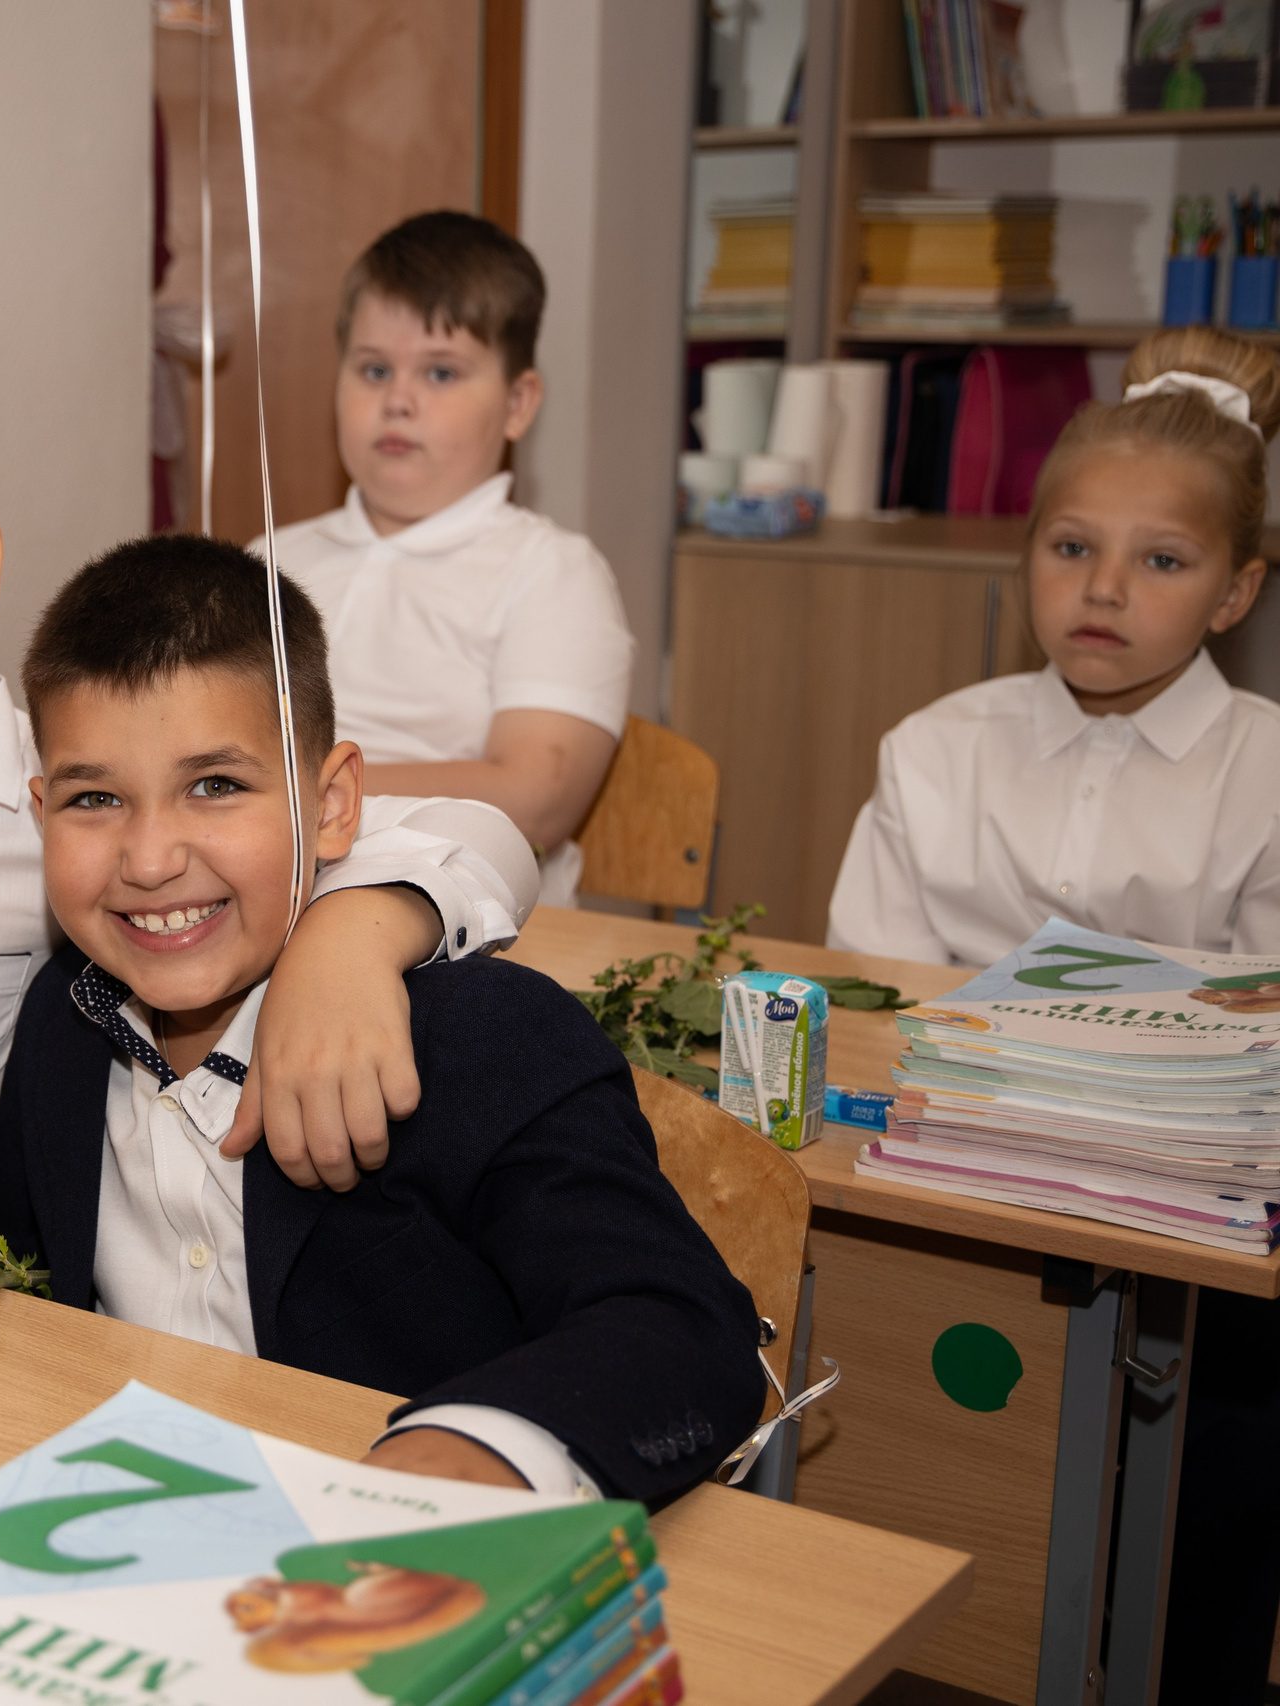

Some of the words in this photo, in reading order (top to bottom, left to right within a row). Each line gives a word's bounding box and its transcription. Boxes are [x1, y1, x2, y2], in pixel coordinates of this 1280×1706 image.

[1013, 944, 1162, 991] 2
[766, 1000, 796, 1018] Мой
[989, 1004, 1280, 1034] Окружающий
[792, 1031, 805, 1072] яблоко
[790, 1073, 803, 1118] Зелёное
